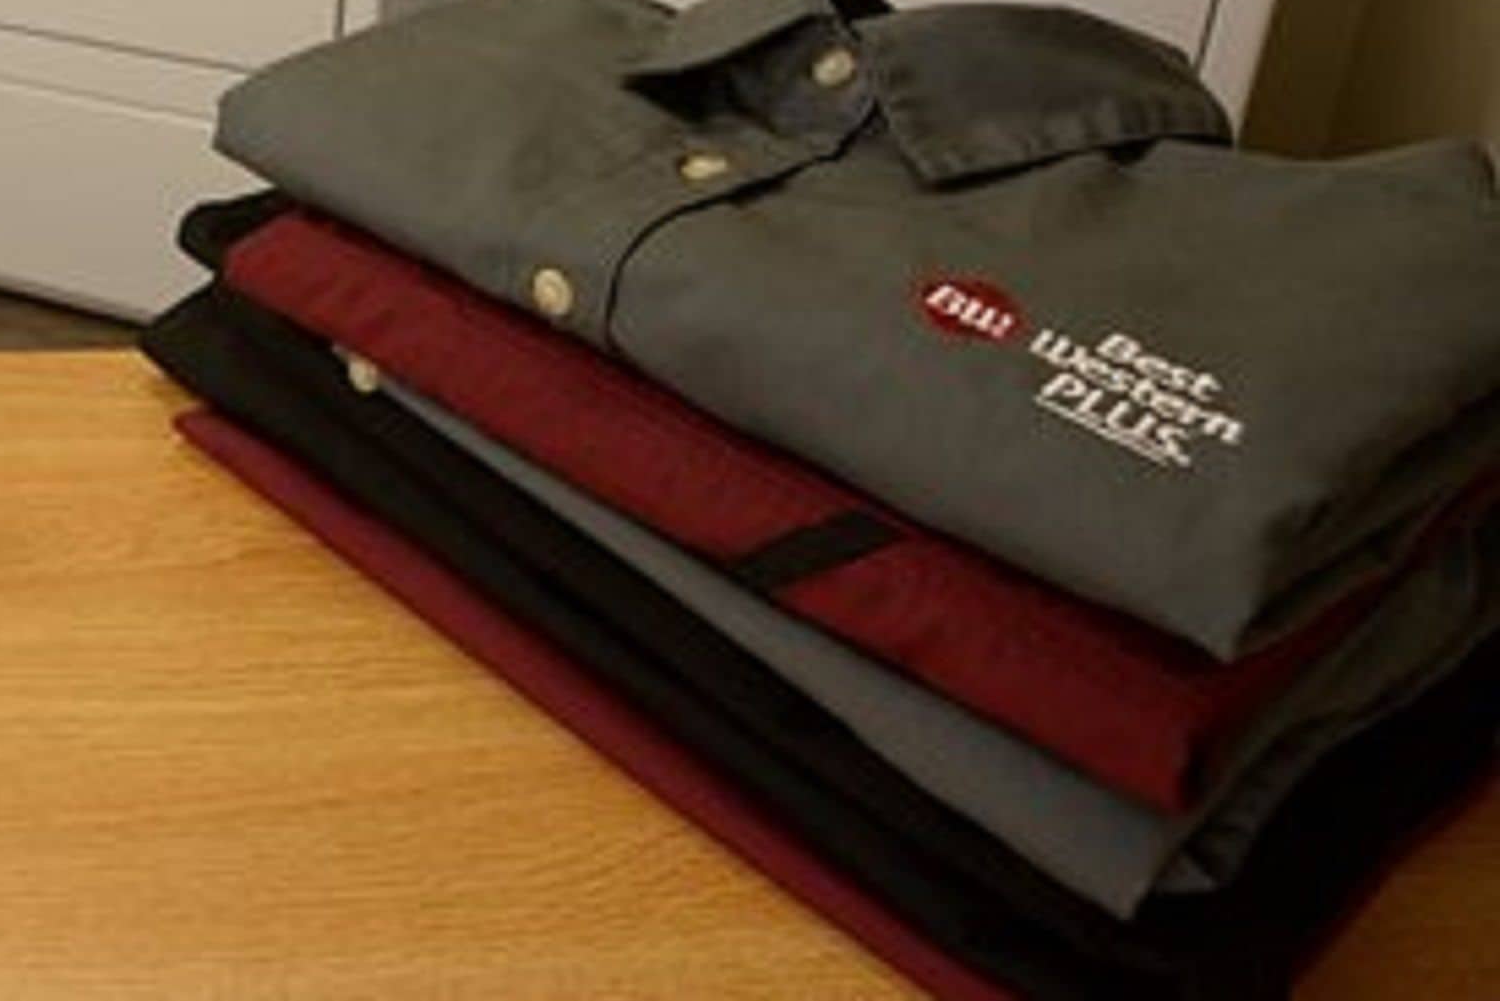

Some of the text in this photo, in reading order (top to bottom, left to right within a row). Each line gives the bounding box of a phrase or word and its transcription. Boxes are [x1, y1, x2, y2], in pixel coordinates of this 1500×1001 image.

[1029, 329, 1245, 445] Western
[1097, 333, 1224, 401] Best
[1040, 372, 1192, 468] PLUS
